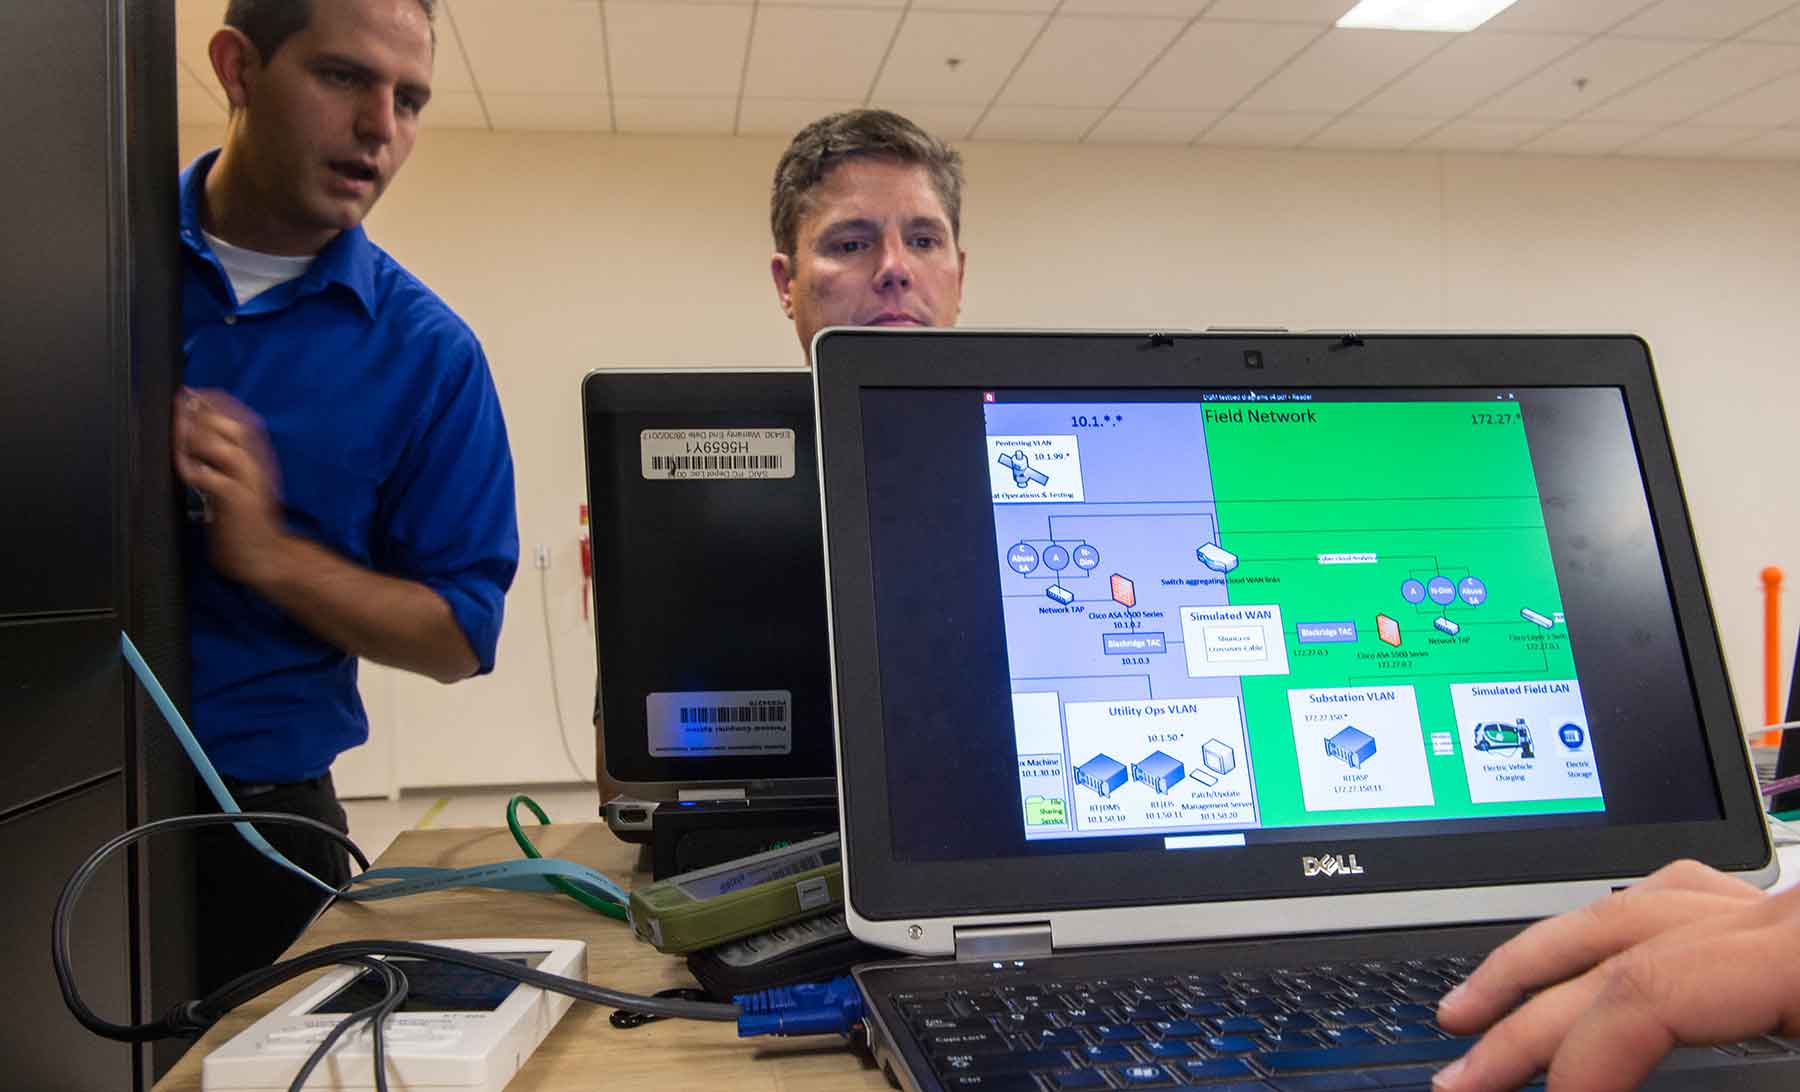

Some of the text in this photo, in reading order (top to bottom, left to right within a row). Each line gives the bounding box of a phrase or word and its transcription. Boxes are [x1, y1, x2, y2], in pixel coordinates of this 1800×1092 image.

[1205, 408, 1318, 424] Field Network
[688, 431, 706, 439] Date
[709, 431, 724, 439] End
[727, 430, 761, 440] Warranty
[686, 441, 749, 455] H5659Y1
[1033, 439, 1053, 447] VLAN
[706, 469, 730, 478] Depot
[1002, 492, 1041, 500] Operations
[1049, 491, 1074, 499] Testing
[1052, 553, 1060, 561] A
[1160, 577, 1185, 586] Switch
[1185, 577, 1226, 587] aggregating
[1245, 576, 1264, 584] WAN
[1264, 576, 1281, 584] links
[1039, 606, 1085, 615] Network TAP
[1088, 612, 1107, 620] Cisco
[1107, 611, 1123, 619] ASA
[1142, 610, 1164, 619] Series
[1190, 609, 1272, 622] Simulated WAN
[1428, 637, 1457, 645] Network
[1471, 682, 1571, 697] Simulated Field LAN
[1308, 690, 1396, 704] Substation VLAN
[1108, 703, 1198, 718] Utility Ops VLAN
[1026, 758, 1059, 768] Machine
[1508, 763, 1533, 771] Vehicle
[1495, 773, 1526, 783] Charging
[1181, 800, 1254, 811] Management Server
[1302, 853, 1365, 877] DELL
